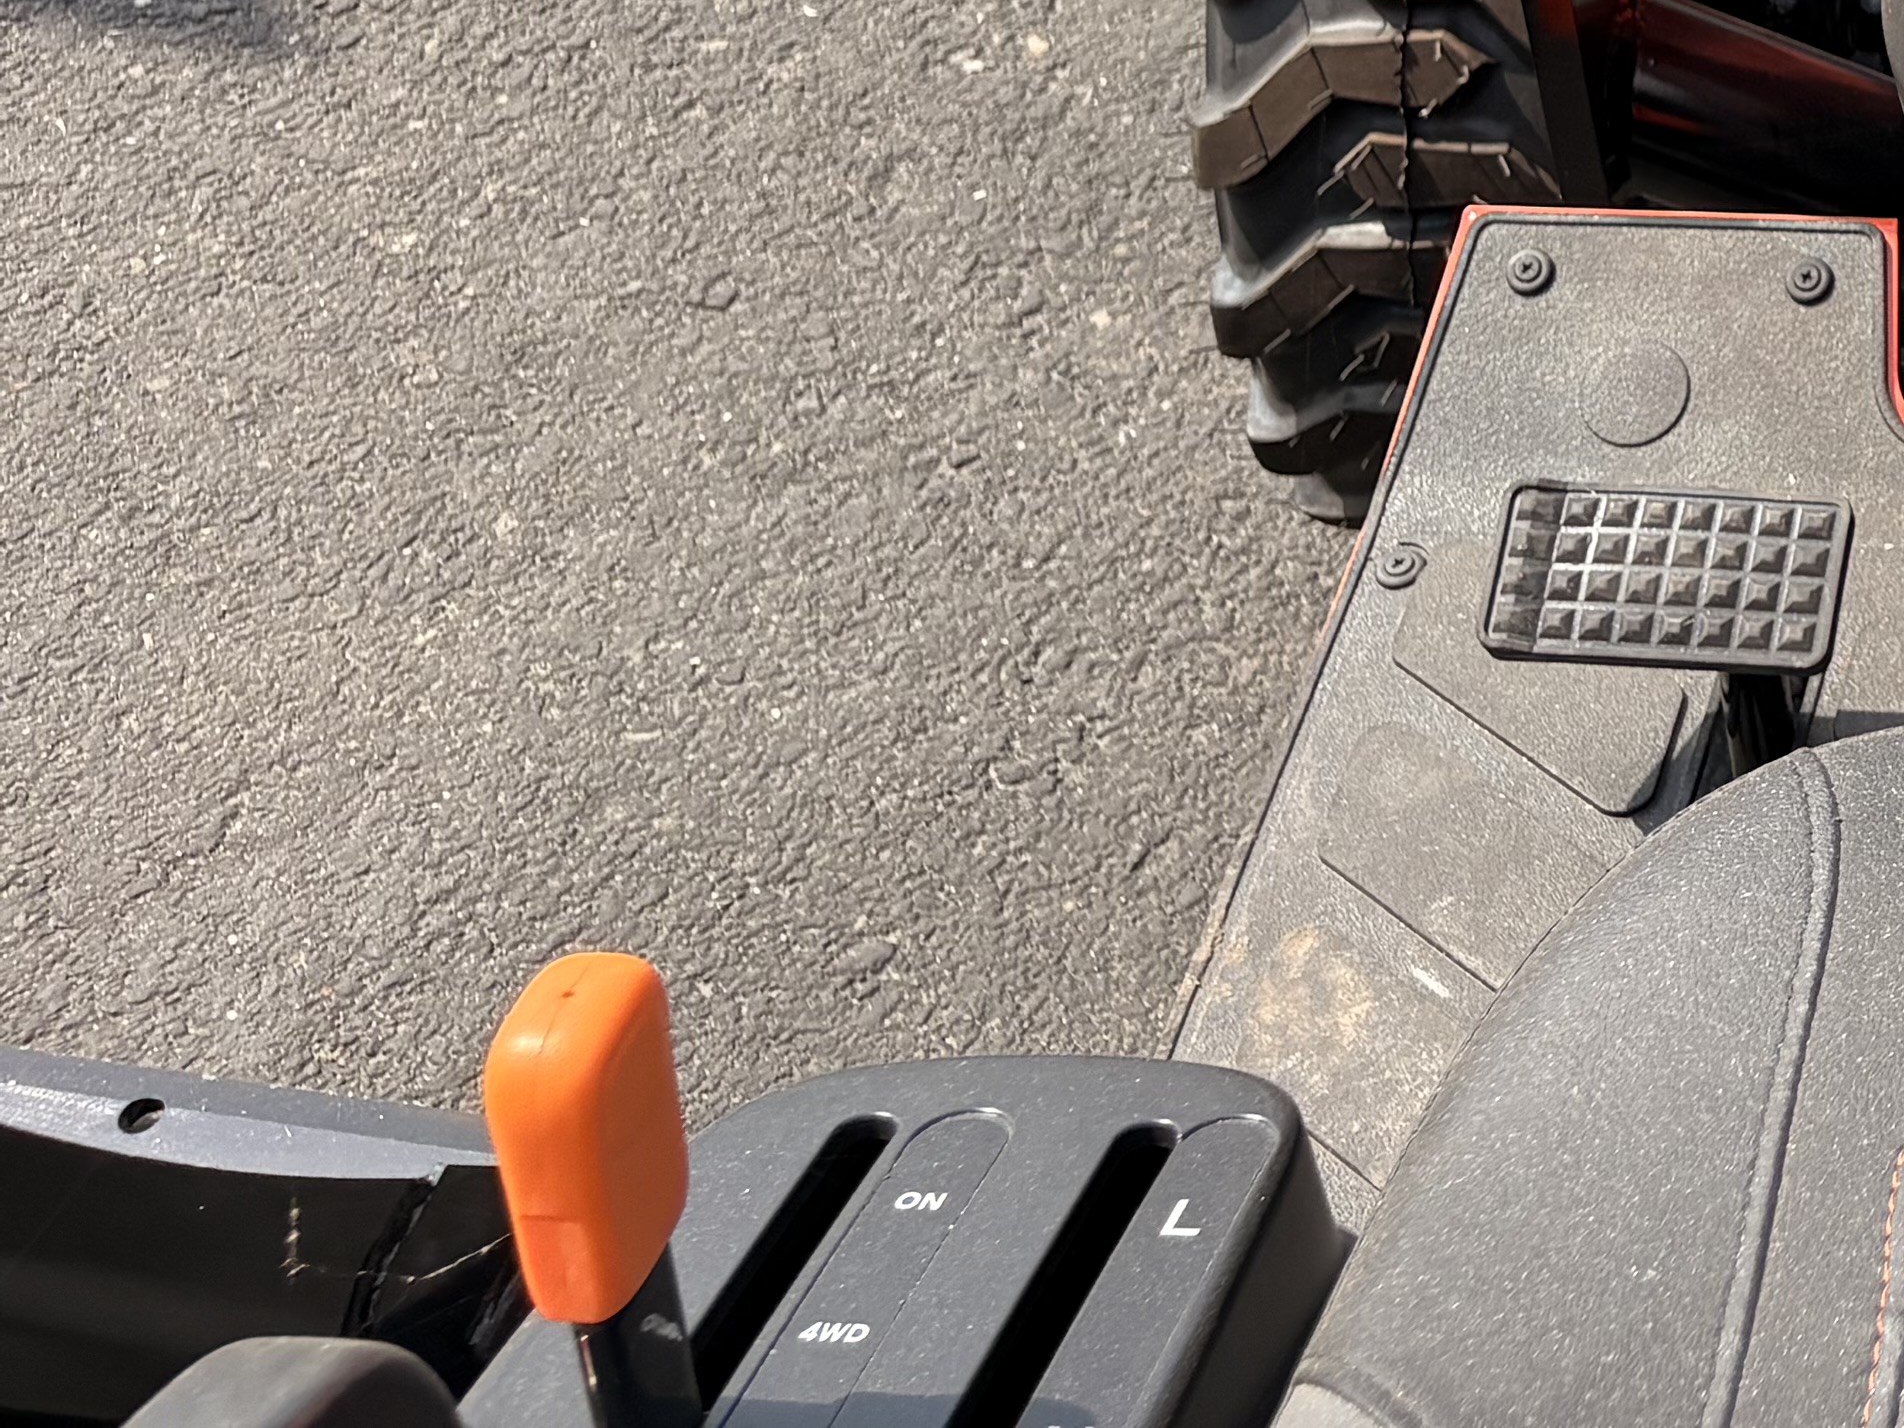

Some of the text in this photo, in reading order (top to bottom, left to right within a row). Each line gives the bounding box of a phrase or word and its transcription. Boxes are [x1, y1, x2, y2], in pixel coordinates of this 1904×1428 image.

[894, 1191, 948, 1212] ON
[1159, 1198, 1202, 1237] L
[799, 1321, 870, 1344] 4WD
